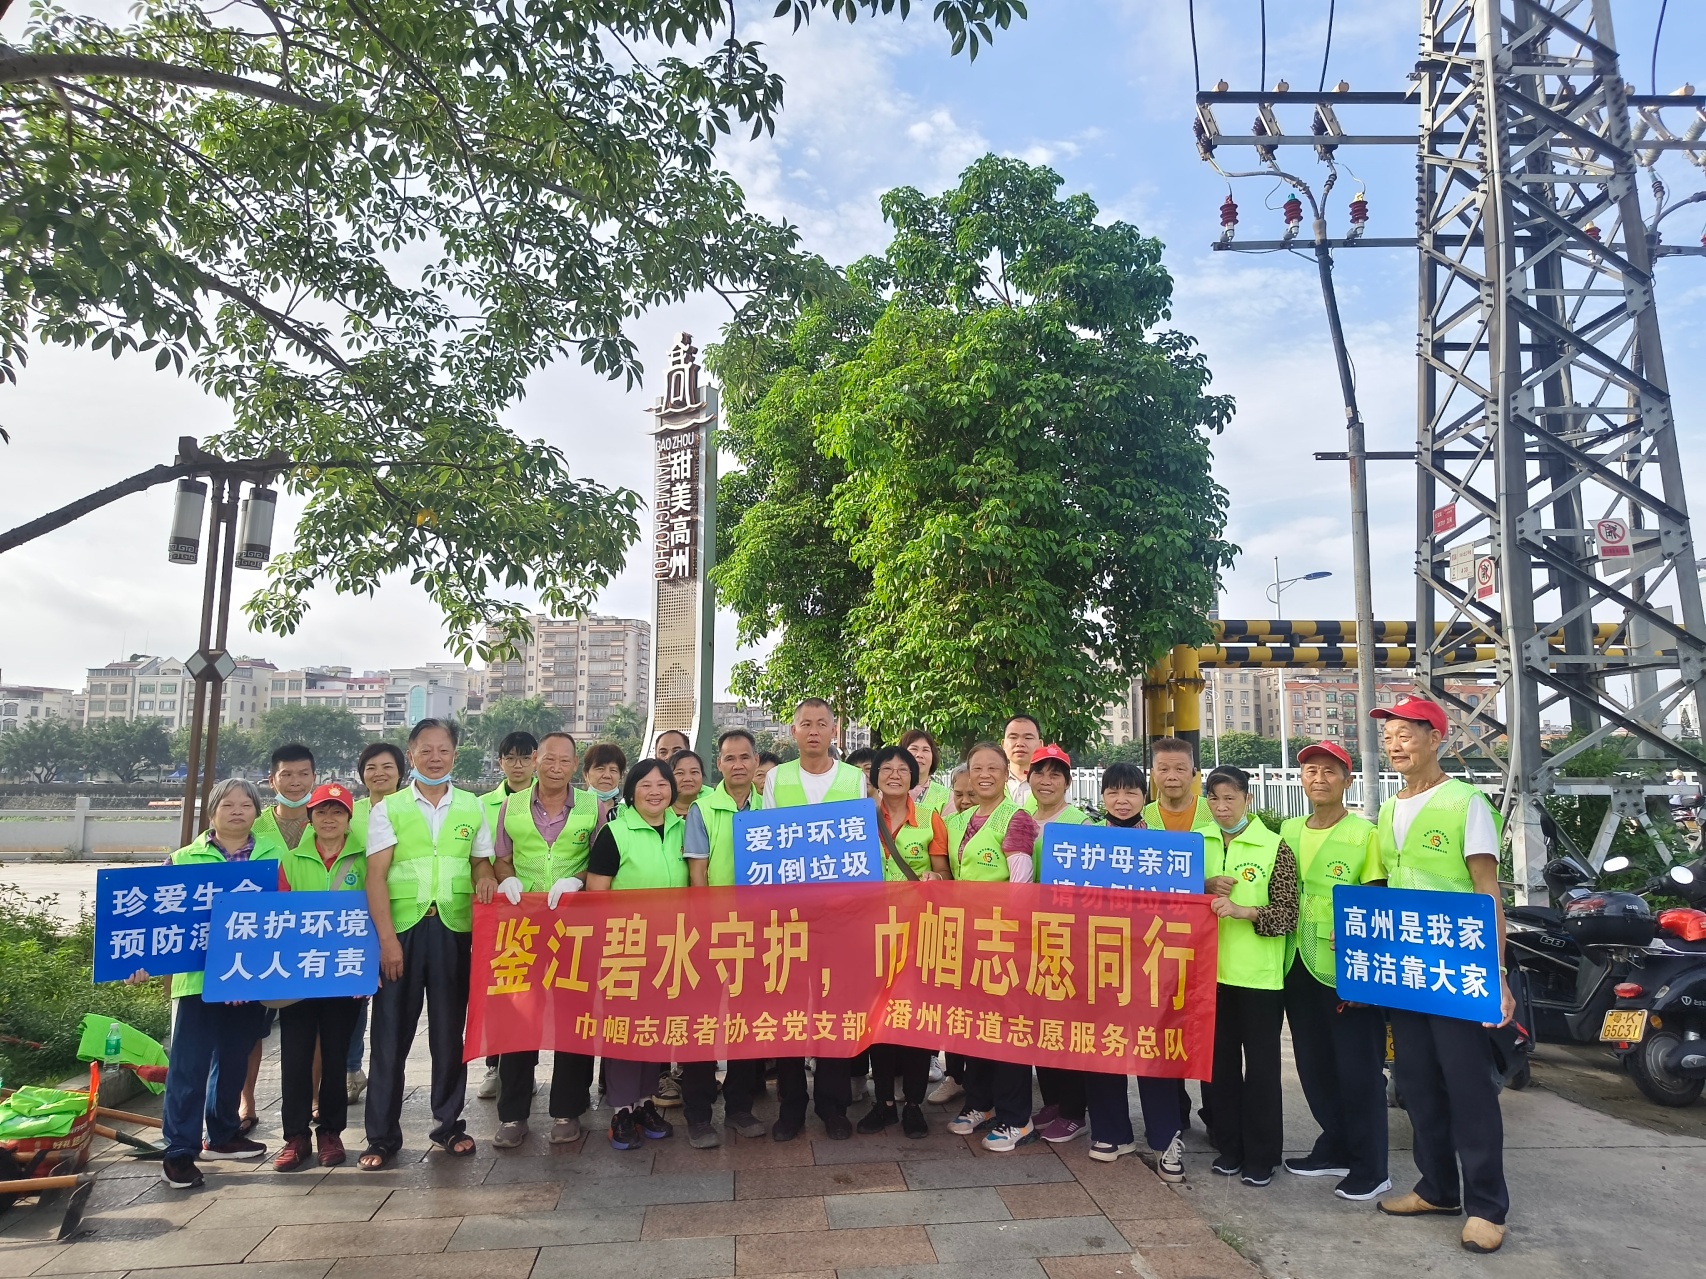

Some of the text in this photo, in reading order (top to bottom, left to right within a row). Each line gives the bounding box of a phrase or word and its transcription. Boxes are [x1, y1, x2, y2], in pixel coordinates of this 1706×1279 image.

[668, 448, 693, 579] 甜美高州
[745, 816, 867, 852] 爱护环境
[746, 851, 871, 886] 勿倒垃圾
[1052, 841, 1193, 878] 守护母亲河
[224, 909, 370, 942] 保护环境
[1343, 905, 1487, 951] 高州是我家
[218, 947, 367, 981] 人人有责
[1344, 948, 1490, 999] 清洁靠大家
[1603, 1024, 1638, 1038] G5C31
